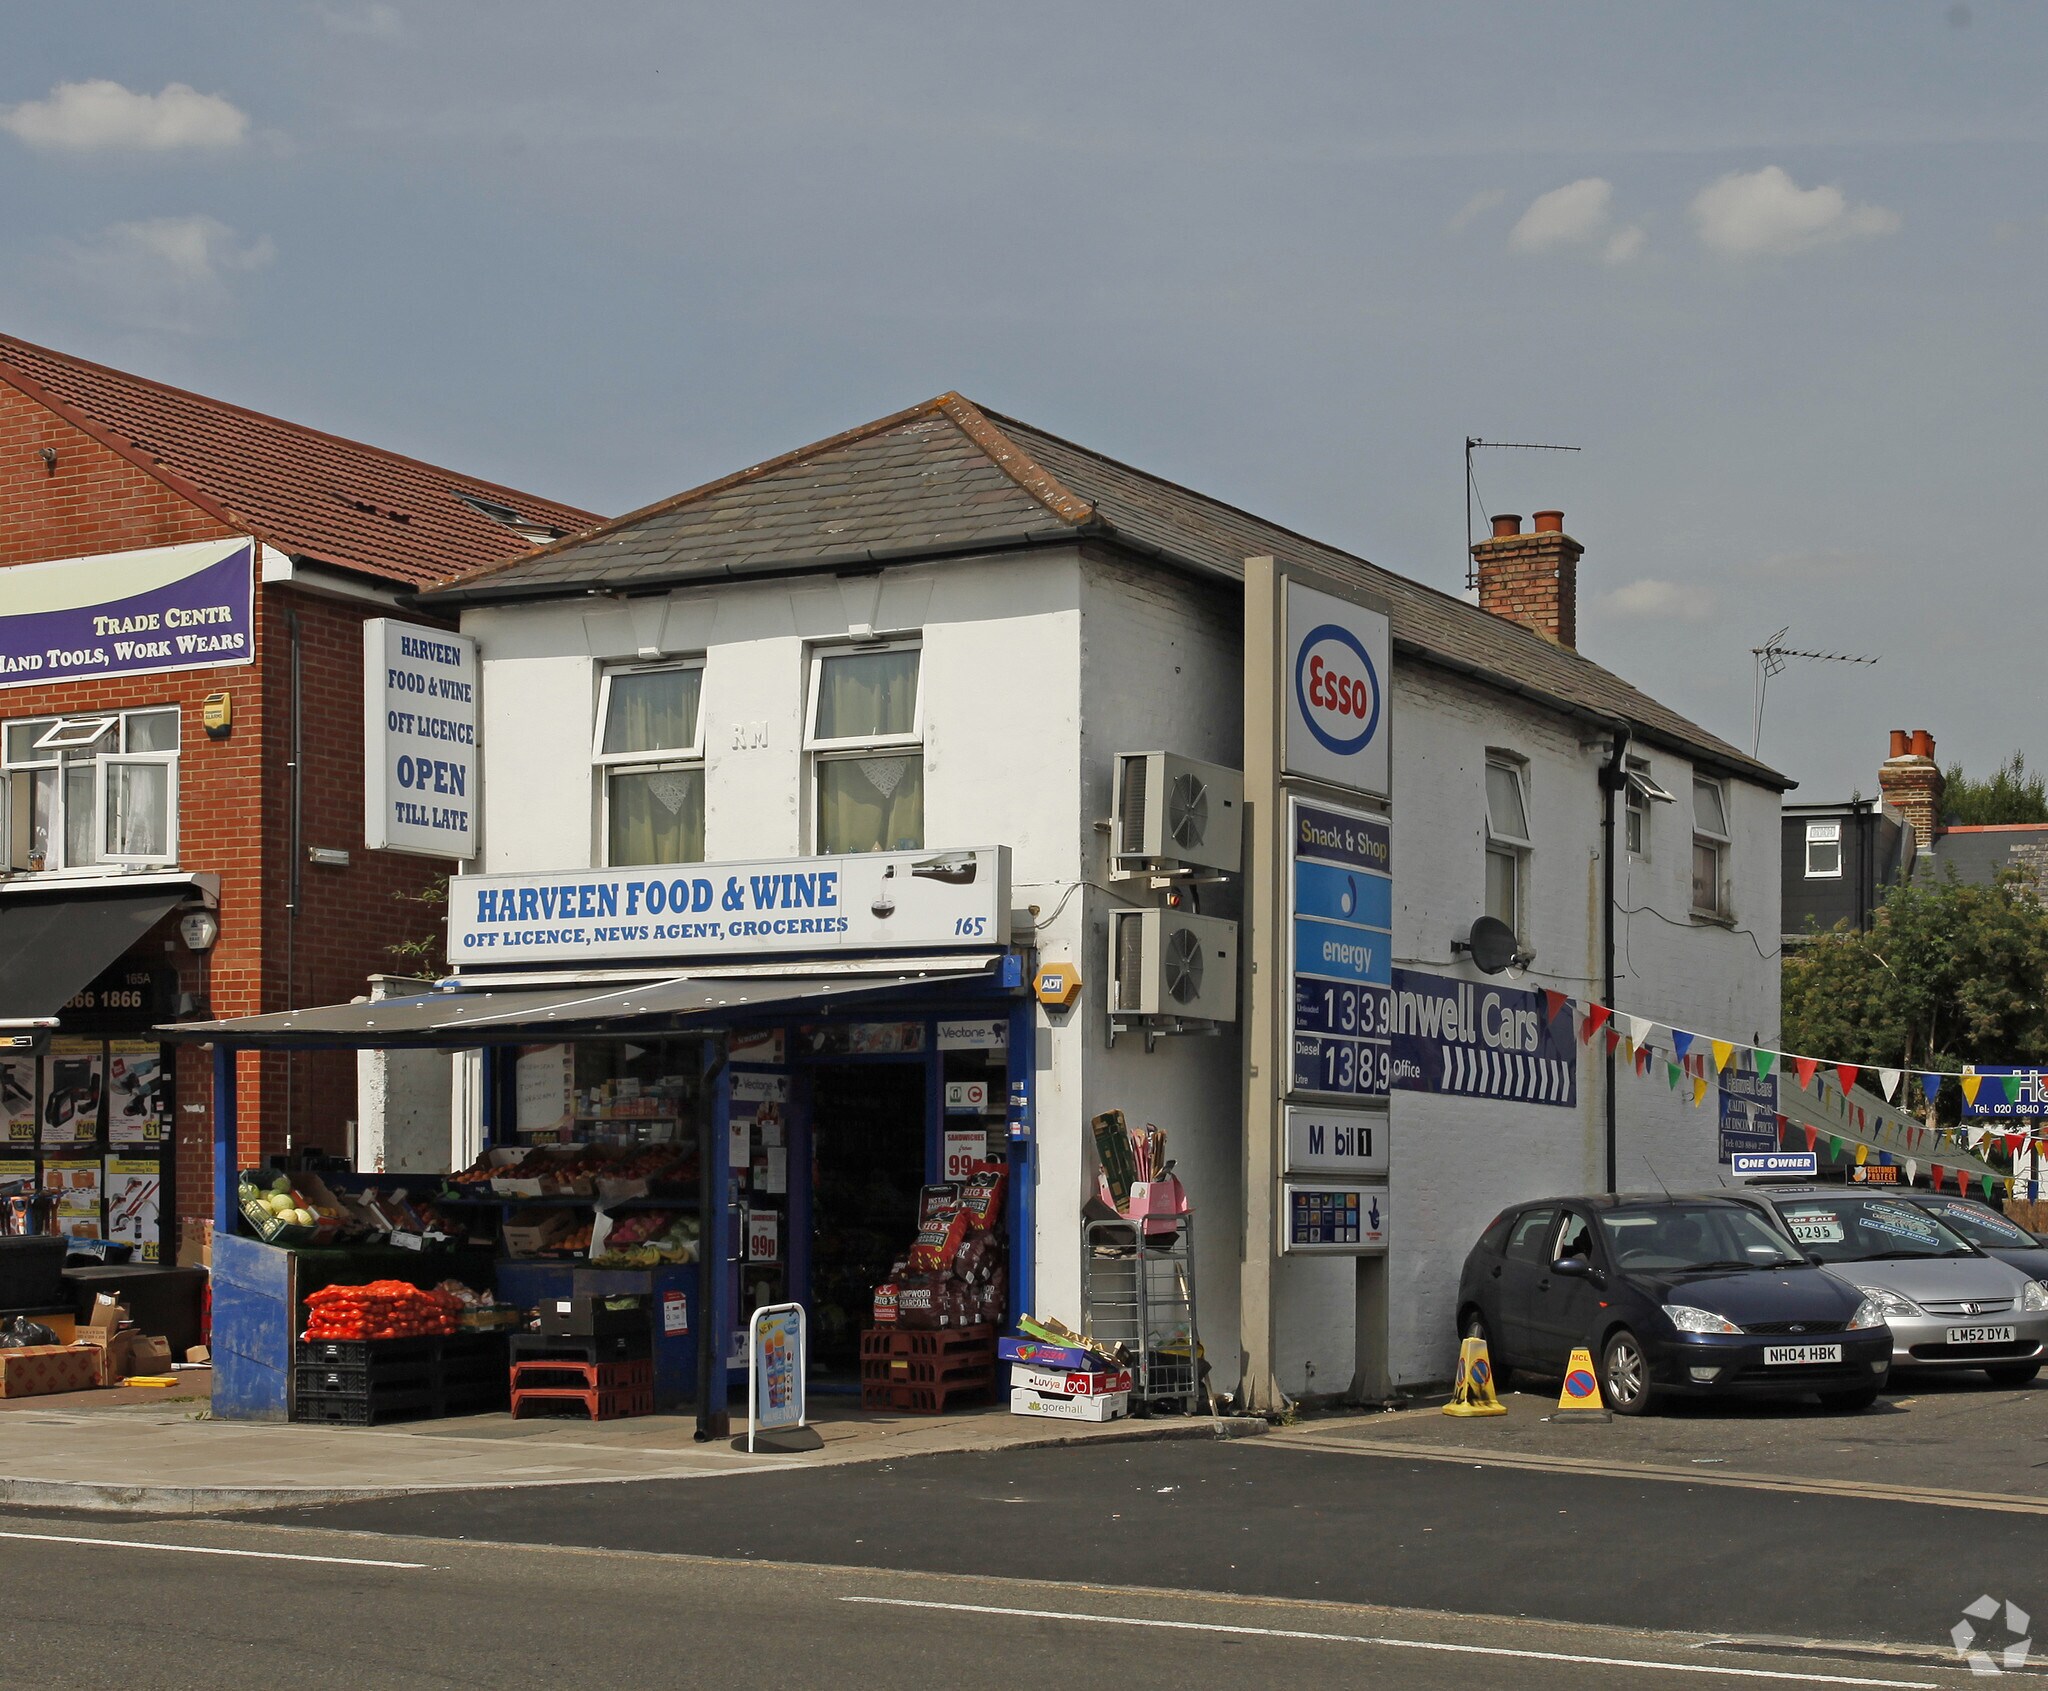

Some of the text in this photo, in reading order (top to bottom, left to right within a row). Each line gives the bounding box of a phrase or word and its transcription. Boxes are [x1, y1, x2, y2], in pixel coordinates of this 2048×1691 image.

[93, 605, 232, 636] TRADE CENTR
[46, 648, 110, 668] TOOLS,
[114, 639, 171, 661] WORK
[176, 633, 244, 653] WEARS
[401, 636, 460, 666] HARVEEN
[388, 669, 472, 703] FOOD & WINE
[388, 711, 474, 745] OFF LICENCE
[397, 755, 466, 797] OPEN
[395, 802, 468, 832] TILL LATE
[1302, 820, 1387, 863] Snack & Shop
[477, 872, 838, 923] HARVEEN FOOD & WINE
[463, 917, 849, 947] OFF LICENCE, NEWS AGENT, GROCERIES
[954, 917, 987, 937] 165
[1323, 941, 1372, 973] energy
[125, 973, 151, 985] 165A
[1041, 978, 1063, 991] ADT
[101, 991, 141, 1008] 1866
[1481, 992, 1538, 1052] Cars
[942, 1027, 986, 1038] Vectone
[1296, 1041, 1320, 1056] Diesel
[1393, 1059, 1421, 1078] Office
[1295, 1074, 1308, 1085] Litre
[1974, 1104, 1990, 1114] Tel:
[1994, 1104, 2012, 1114] 020
[2016, 1104, 2039, 1114] 8840
[11, 1123, 34, 1136] £325
[1738, 1157, 1811, 1168] ONE OWNER
[963, 1188, 992, 1198] BIG K
[752, 1235, 775, 1257] 99p
[1952, 1328, 2010, 1341] LM52 DYA
[1572, 1354, 1589, 1362] MCL
[1770, 1347, 1836, 1361] NH04 HBK
[1042, 1403, 1083, 1414] gorehall
